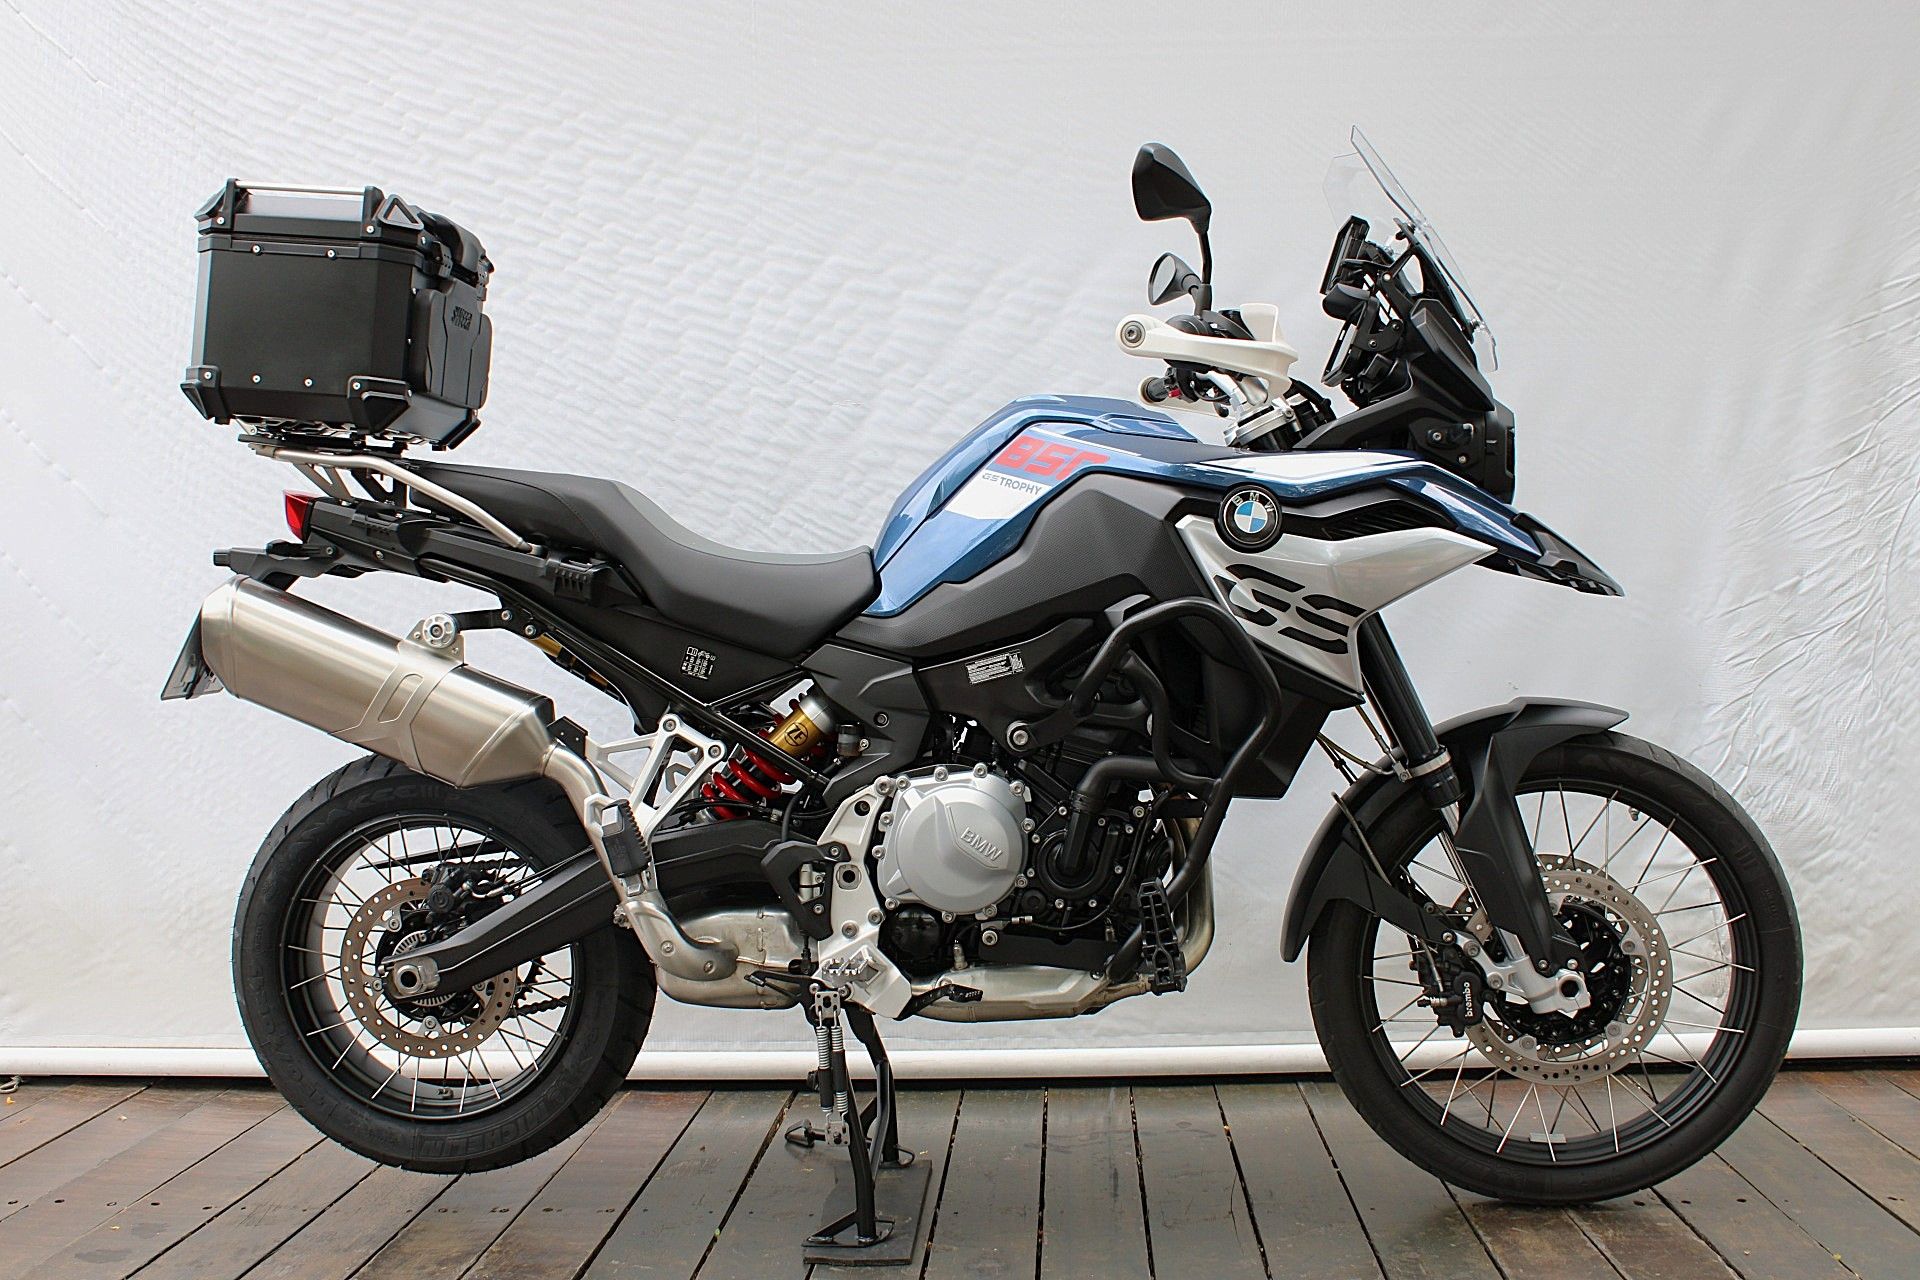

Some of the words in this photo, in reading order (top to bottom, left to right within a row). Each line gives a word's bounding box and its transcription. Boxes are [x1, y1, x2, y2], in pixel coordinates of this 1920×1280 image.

[1000, 477, 1042, 495] TROPHY
[1232, 492, 1275, 513] BMW
[1213, 563, 1368, 655] GS
[960, 827, 1003, 862] BMW
[1463, 981, 1473, 1018] brembo
